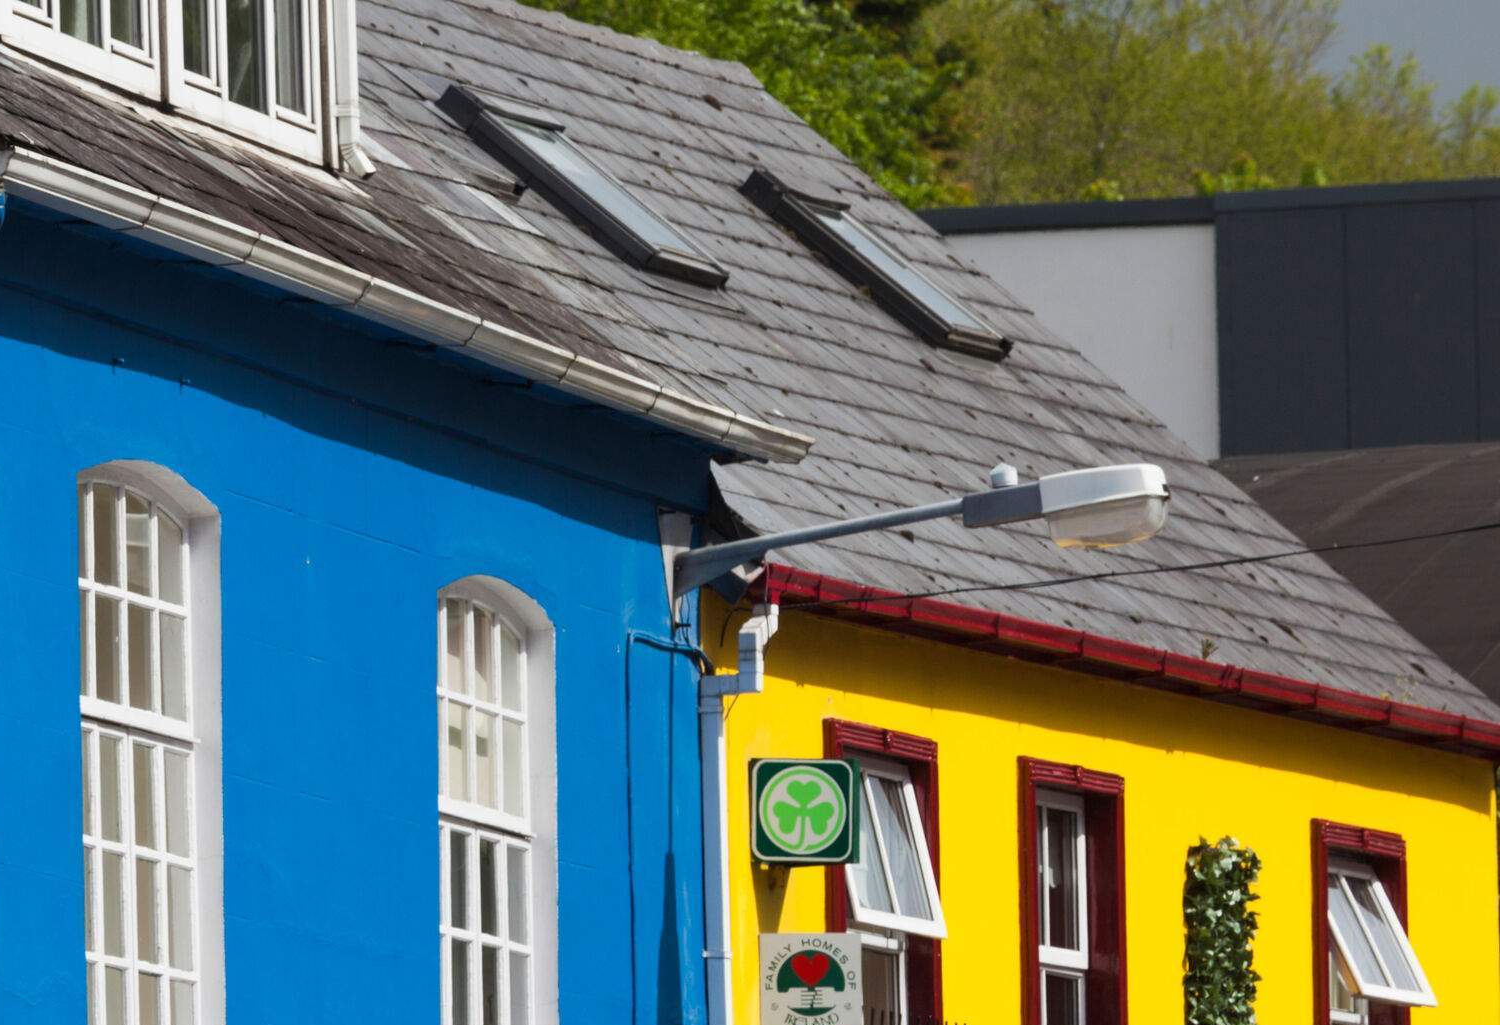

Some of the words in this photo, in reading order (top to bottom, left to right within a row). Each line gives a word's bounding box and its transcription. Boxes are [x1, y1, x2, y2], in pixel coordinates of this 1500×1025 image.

[765, 944, 791, 991] FAMILY
[801, 938, 849, 965] HOMES
[846, 970, 857, 991] OF
